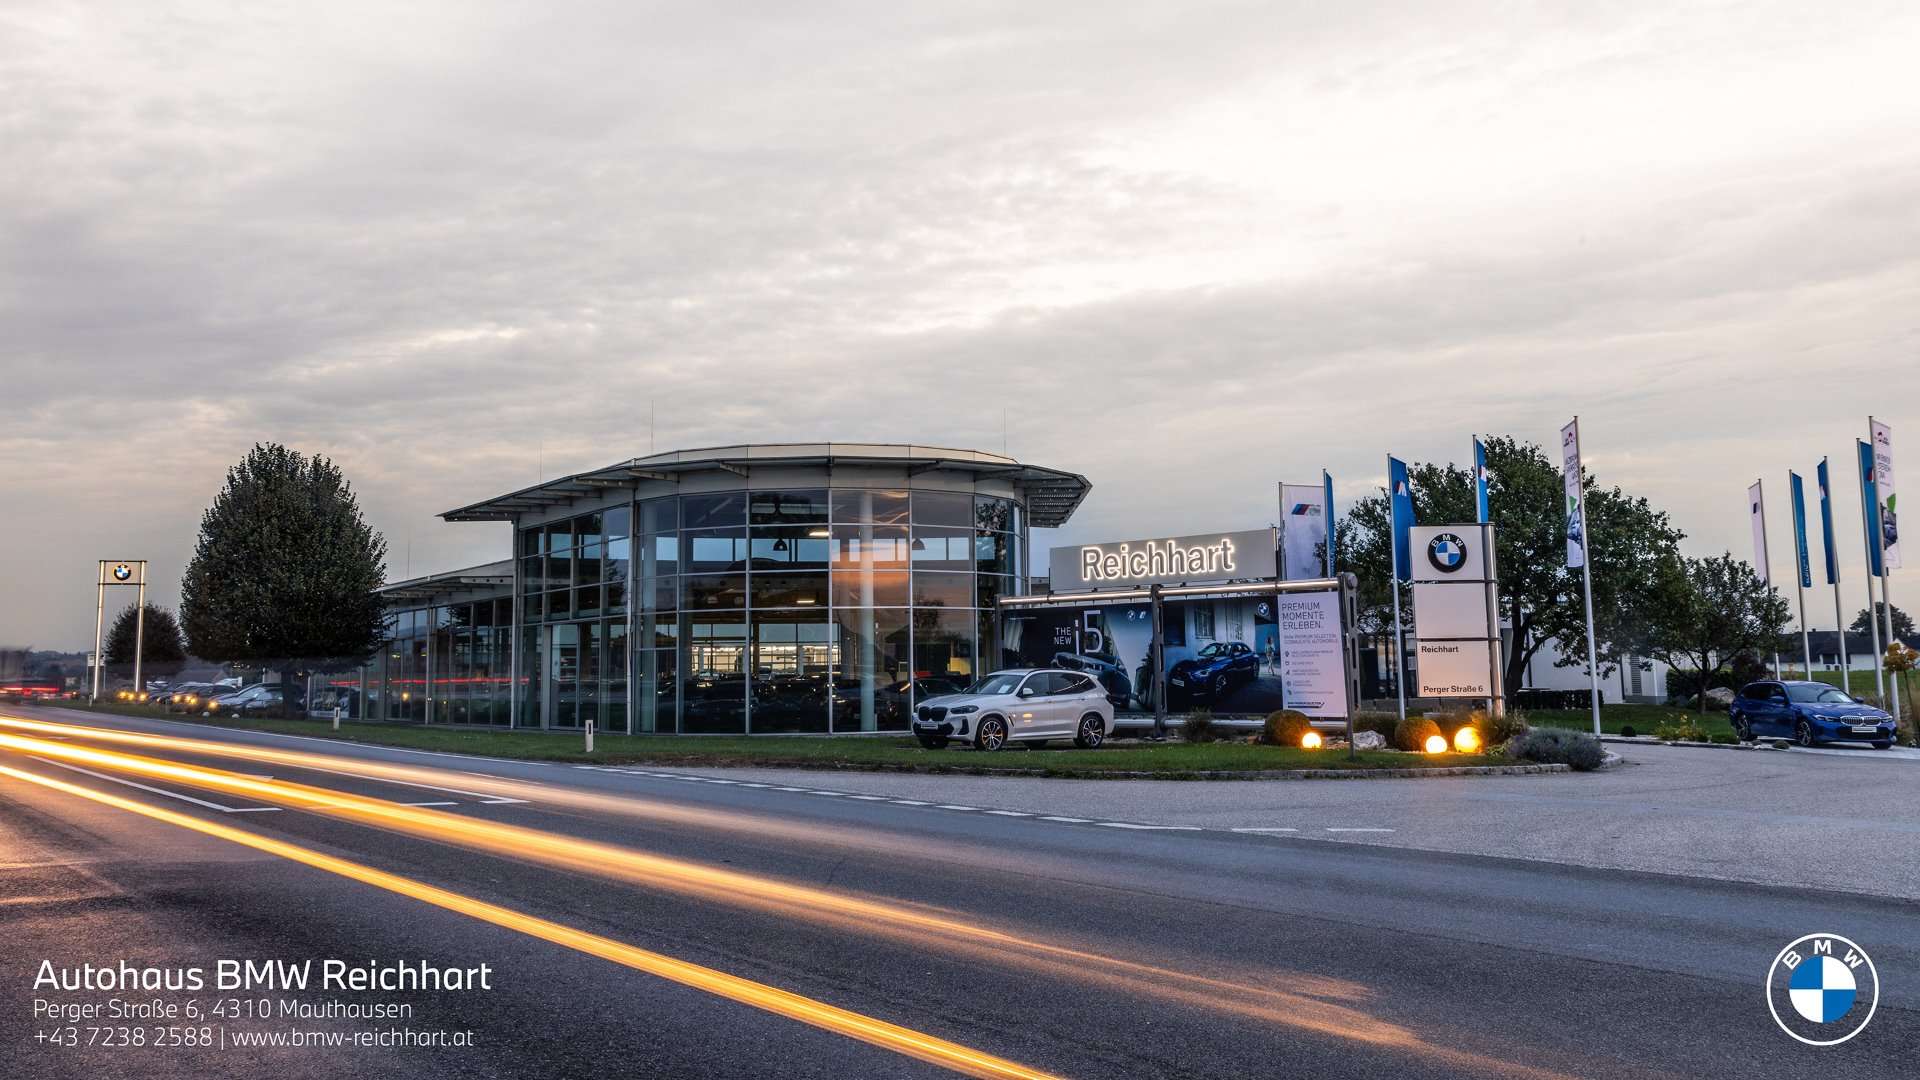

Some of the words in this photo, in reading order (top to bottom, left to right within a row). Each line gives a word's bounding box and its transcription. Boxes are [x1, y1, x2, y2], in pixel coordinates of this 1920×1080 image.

[1431, 534, 1464, 548] BMW
[1082, 538, 1235, 581] Reichhart
[1281, 602, 1320, 611] PREMIUM
[1282, 611, 1325, 621] MOMENTE
[1055, 626, 1072, 636] THE
[1054, 636, 1072, 645] NEW
[1421, 645, 1459, 653] Reichhart
[1423, 685, 1450, 694] Perger
[1450, 685, 1477, 693] Straße
[1478, 685, 1484, 693] 6
